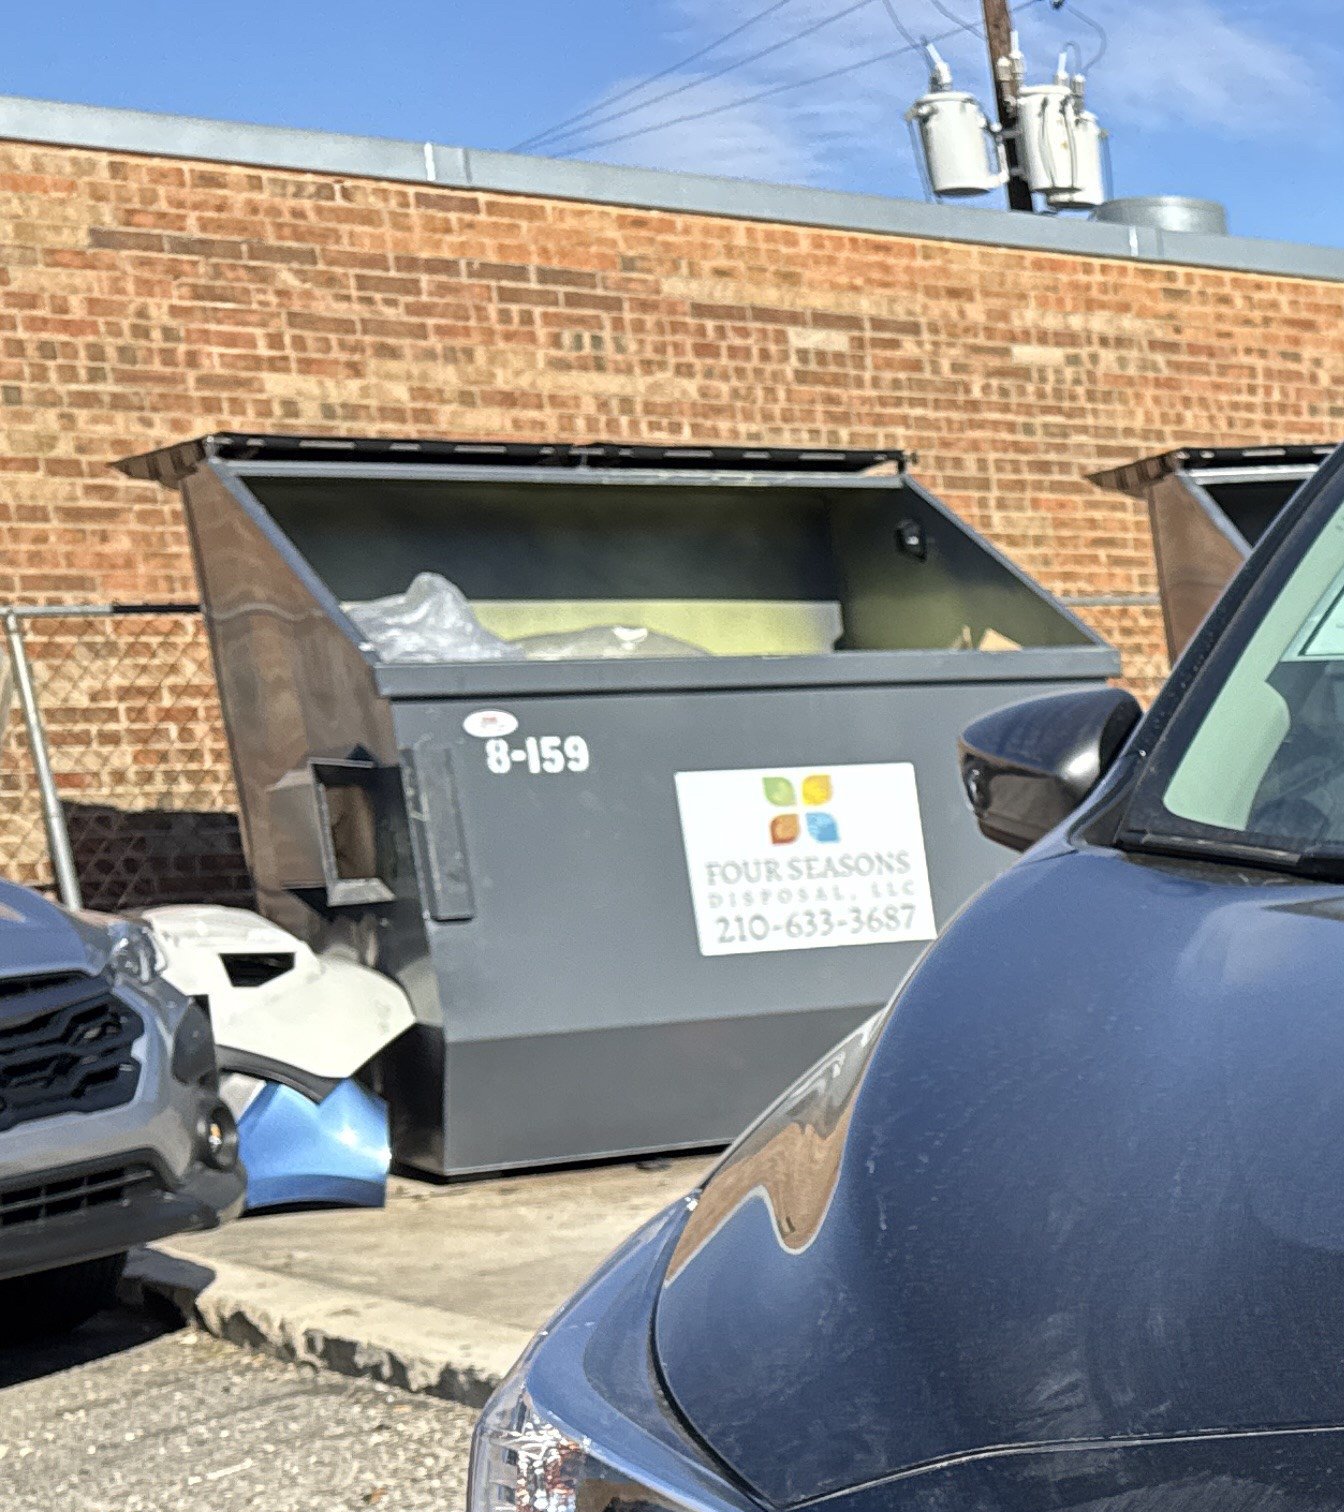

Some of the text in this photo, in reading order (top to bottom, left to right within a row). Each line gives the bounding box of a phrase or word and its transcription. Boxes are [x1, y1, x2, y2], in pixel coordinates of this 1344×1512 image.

[485, 735, 590, 774] 8-159
[704, 849, 912, 886] FOUR SEASONS
[871, 879, 915, 898] LLC
[715, 902, 916, 944] 210-633-3687
